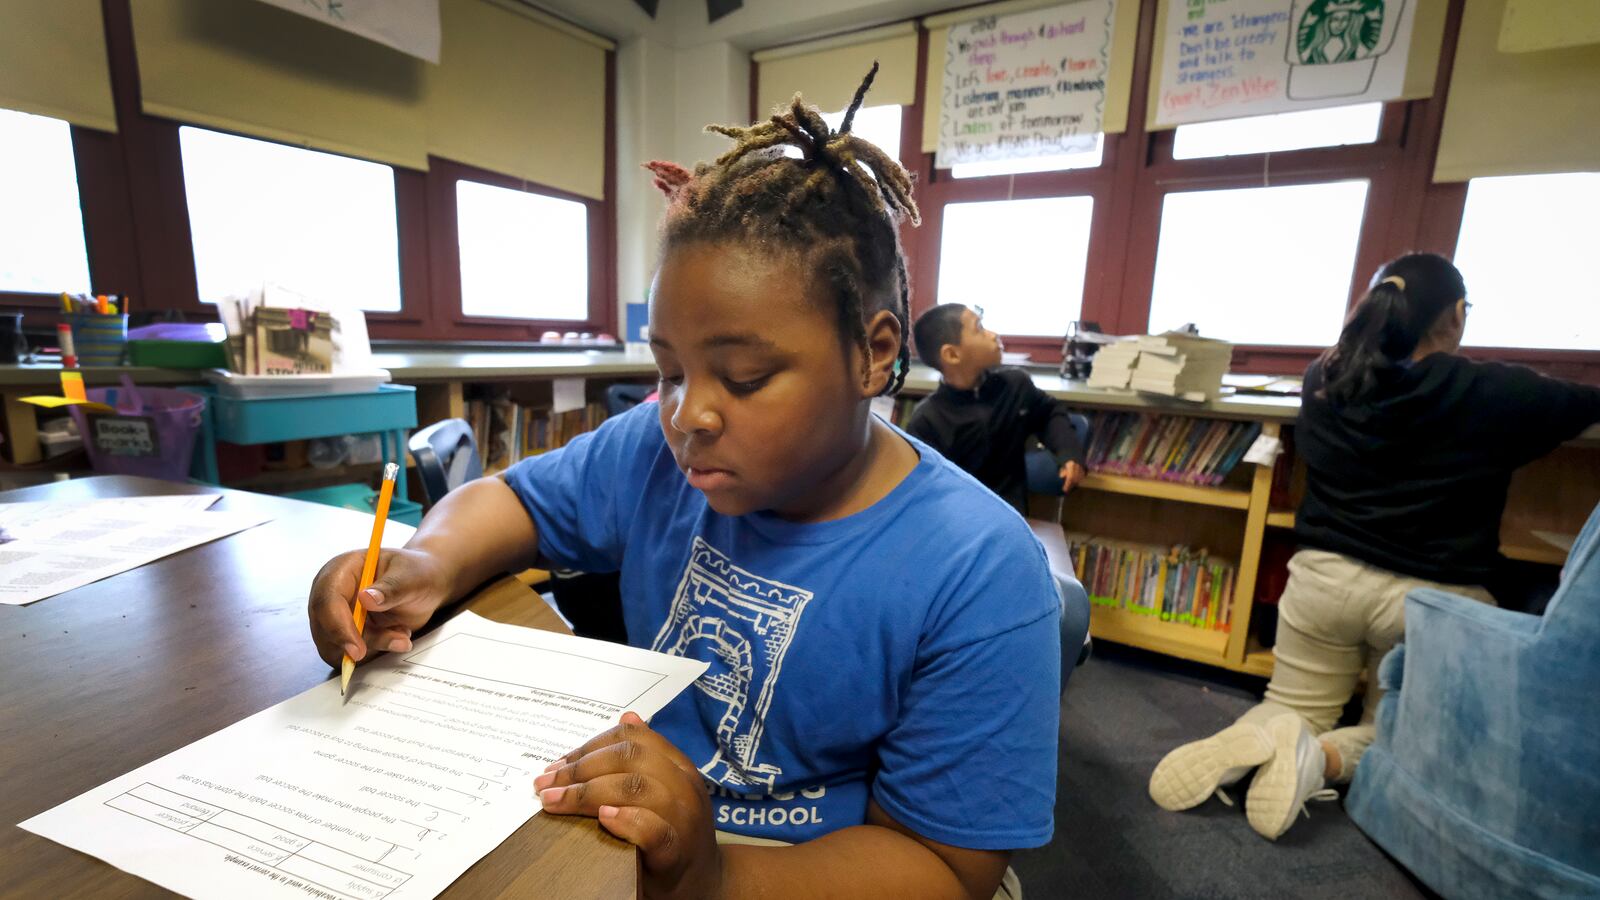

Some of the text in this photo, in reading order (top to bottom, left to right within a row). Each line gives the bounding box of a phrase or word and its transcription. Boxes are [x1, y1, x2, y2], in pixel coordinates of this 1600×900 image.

[560, 705, 594, 714] connection
[593, 712, 611, 720] What
[334, 758, 361, 767] soccer
[383, 771, 405, 779] taker
[199, 780, 216, 789] has
[271, 779, 299, 791] soccer
[403, 776, 427, 786] ticket
[214, 785, 236, 794] store
[297, 788, 313, 796] the
[427, 783, 442, 791] the
[233, 791, 249, 799] the
[247, 795, 268, 805] balls
[311, 793, 334, 803] make
[376, 790, 406, 802] soccer
[266, 802, 296, 814] soccer
[334, 800, 352, 808] who
[404, 799, 421, 807] the
[293, 811, 312, 820] new
[351, 806, 383, 818] people
[717, 805, 823, 825] SCHOOL
[155, 812, 190, 825] producer
[380, 815, 396, 824] the
[320, 822, 356, 835] number
[272, 834, 298, 845] good
[354, 832, 371, 842] the
[246, 845, 276, 857] service
[246, 864, 270, 875] correct
[352, 864, 393, 880] consumer
[268, 872, 280, 880] the
[284, 879, 303, 888] word
[347, 880, 374, 894] supply
